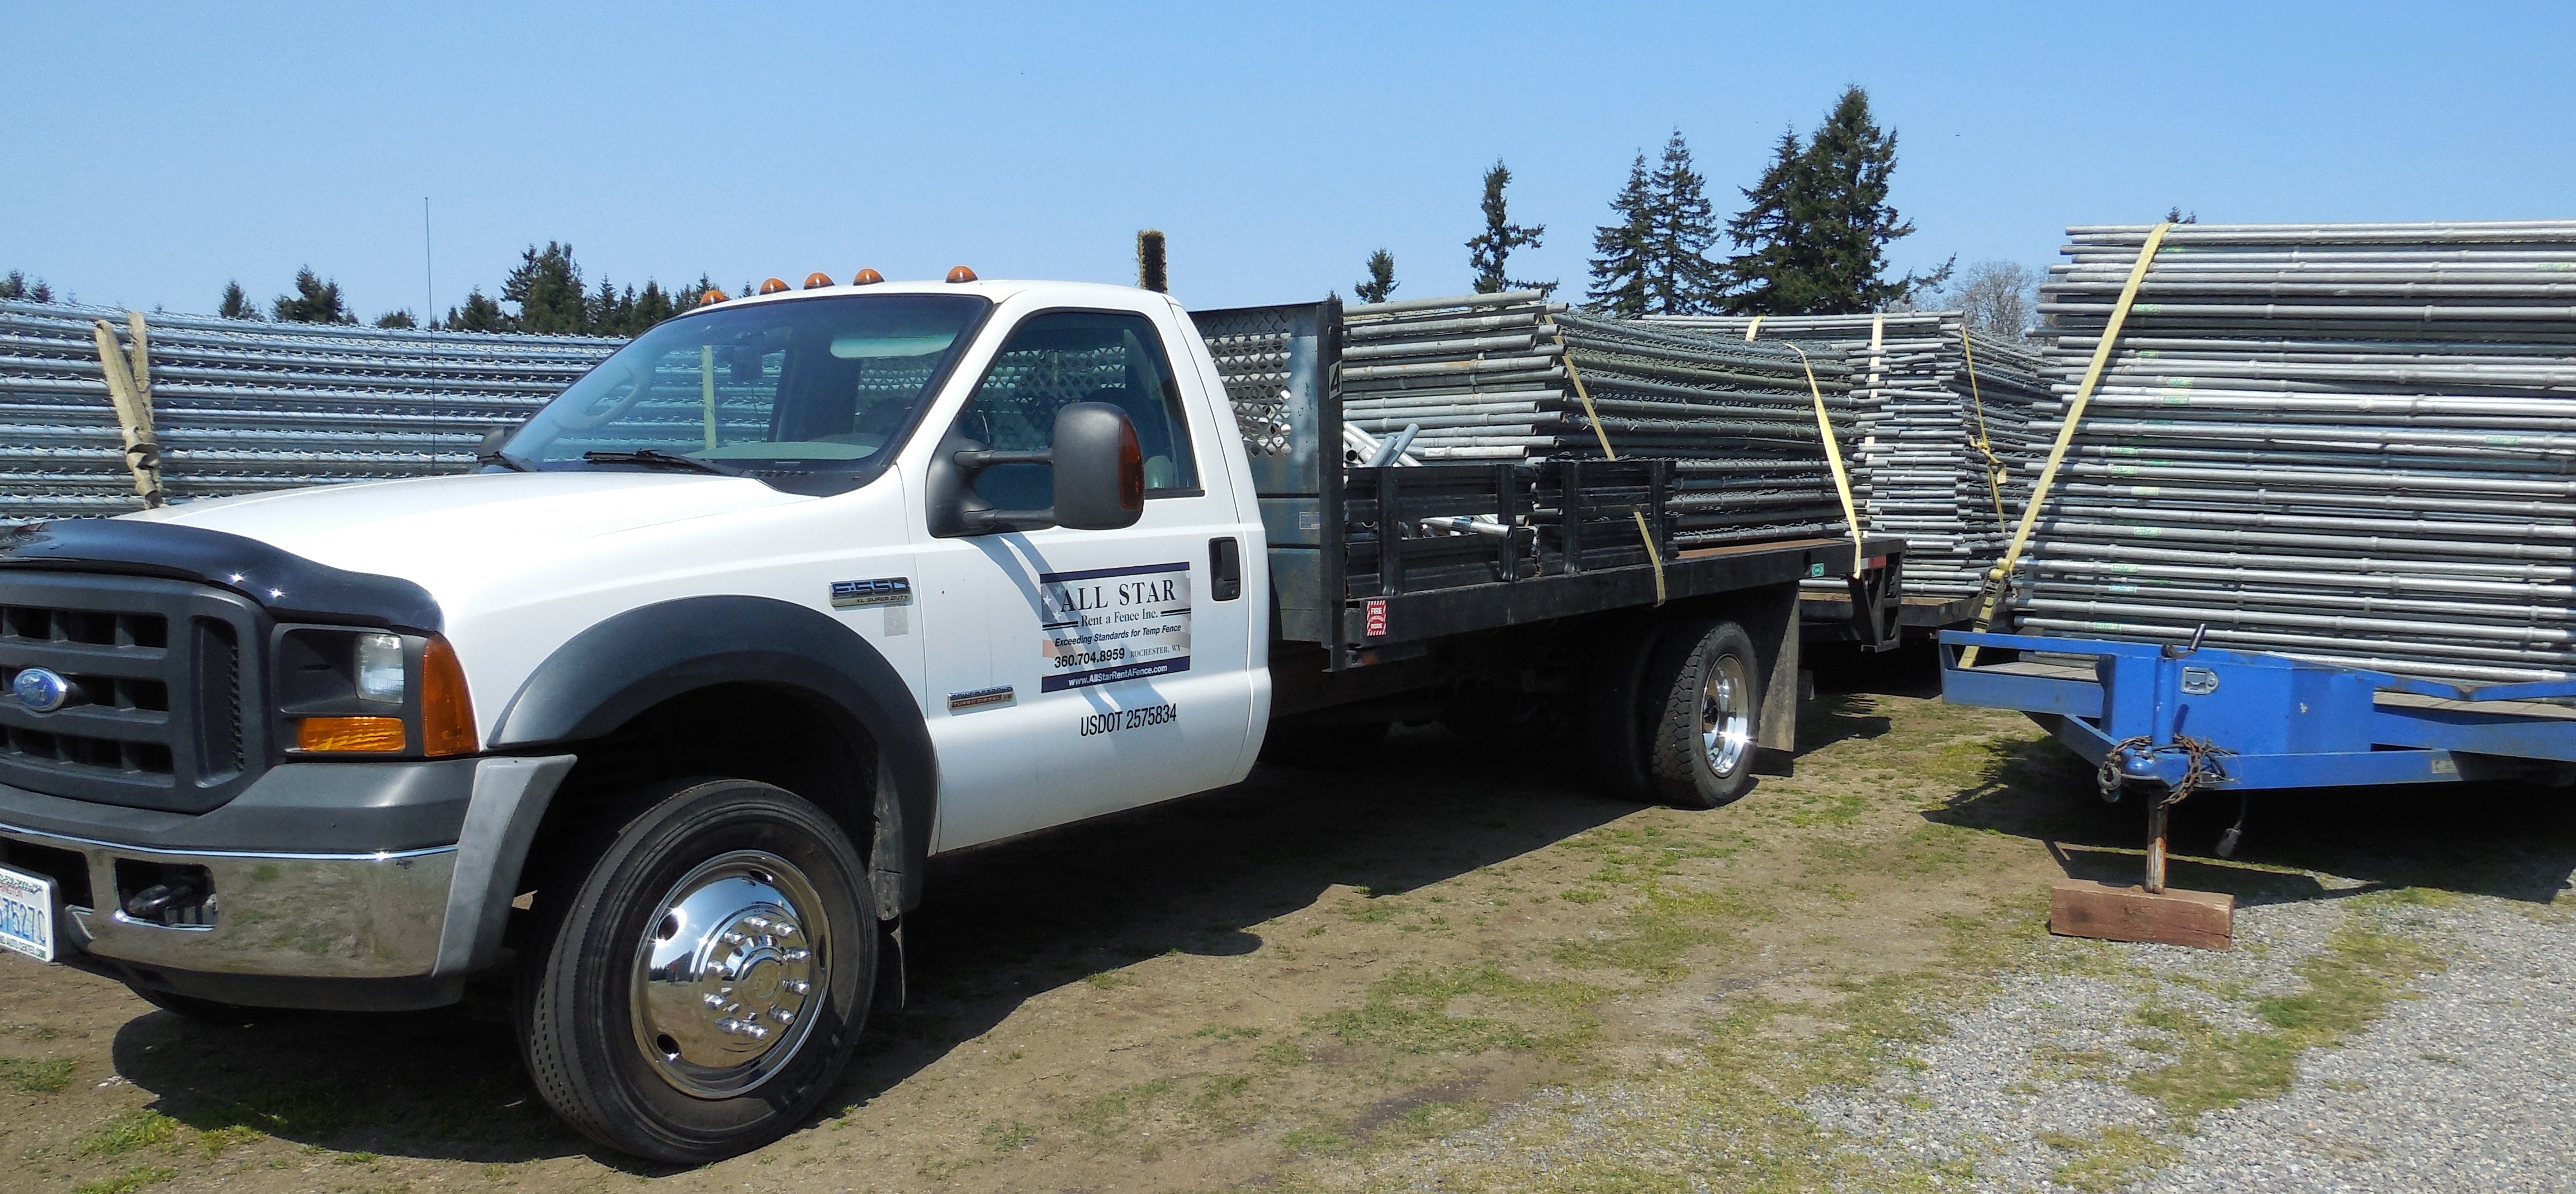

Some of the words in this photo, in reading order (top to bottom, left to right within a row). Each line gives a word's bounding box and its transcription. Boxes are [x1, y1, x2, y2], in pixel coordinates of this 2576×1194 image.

[1330, 364, 1341, 392] 4
[1060, 586, 1109, 612] ALL
[1119, 580, 1176, 606] STAR
[1081, 614, 1102, 627] Rent
[1114, 610, 1139, 623] Fence
[1143, 609, 1158, 619] Inc.
[1055, 636, 1092, 647] Exceeding
[1094, 630, 1129, 642] Standards
[1131, 629, 1140, 637] for
[1143, 626, 1160, 636] Temp
[1162, 624, 1181, 633] Fence
[1054, 647, 1125, 668] 360.704.8959
[1068, 664, 1167, 686] www.AllStarRentAFence.com
[1081, 711, 1123, 737] USDOT
[1126, 703, 1177, 729] 2575834
